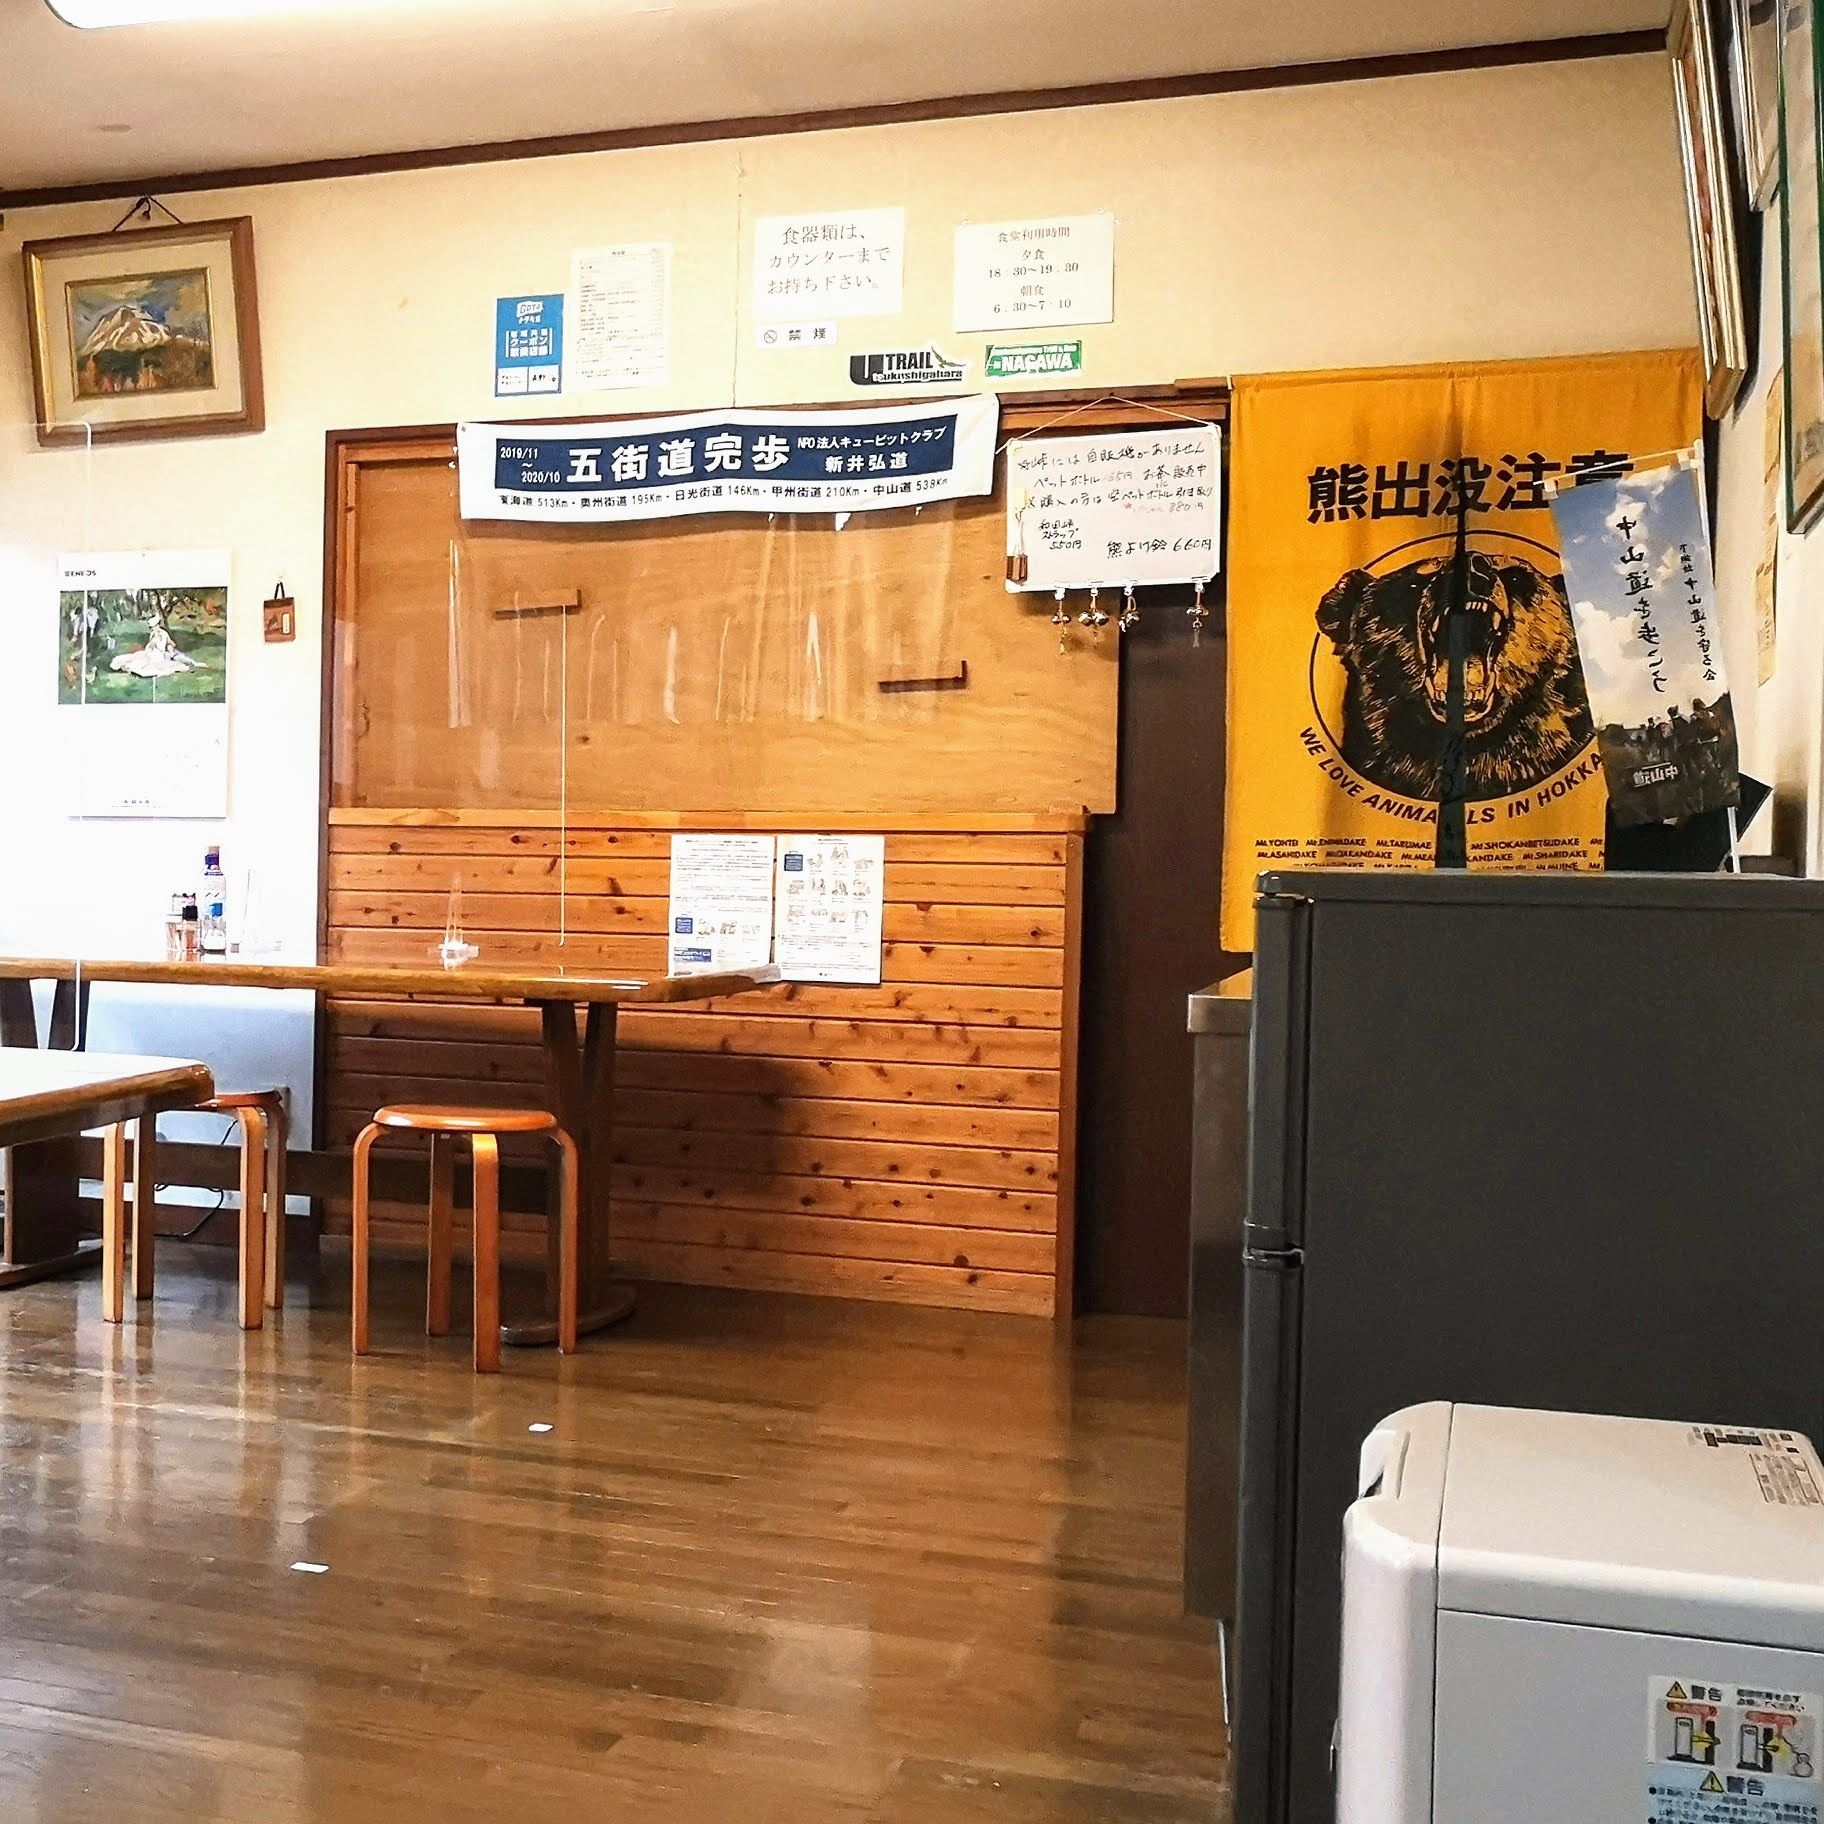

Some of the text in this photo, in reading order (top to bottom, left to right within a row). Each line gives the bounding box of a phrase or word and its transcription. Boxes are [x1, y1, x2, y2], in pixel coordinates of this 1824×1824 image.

[782, 224, 865, 245] 食器類は、
[998, 226, 1071, 243] 食堂利用時間
[769, 247, 891, 268] カウンターまで
[767, 274, 879, 295] お持ち下さい。
[566, 433, 791, 484] 五街道完歩
[825, 451, 909, 473] 新井弘道
[520, 470, 561, 484] 2020/10
[1300, 726, 1326, 756] WE
[1318, 755, 1364, 798] LOVE
[1507, 797, 1531, 819] IN
